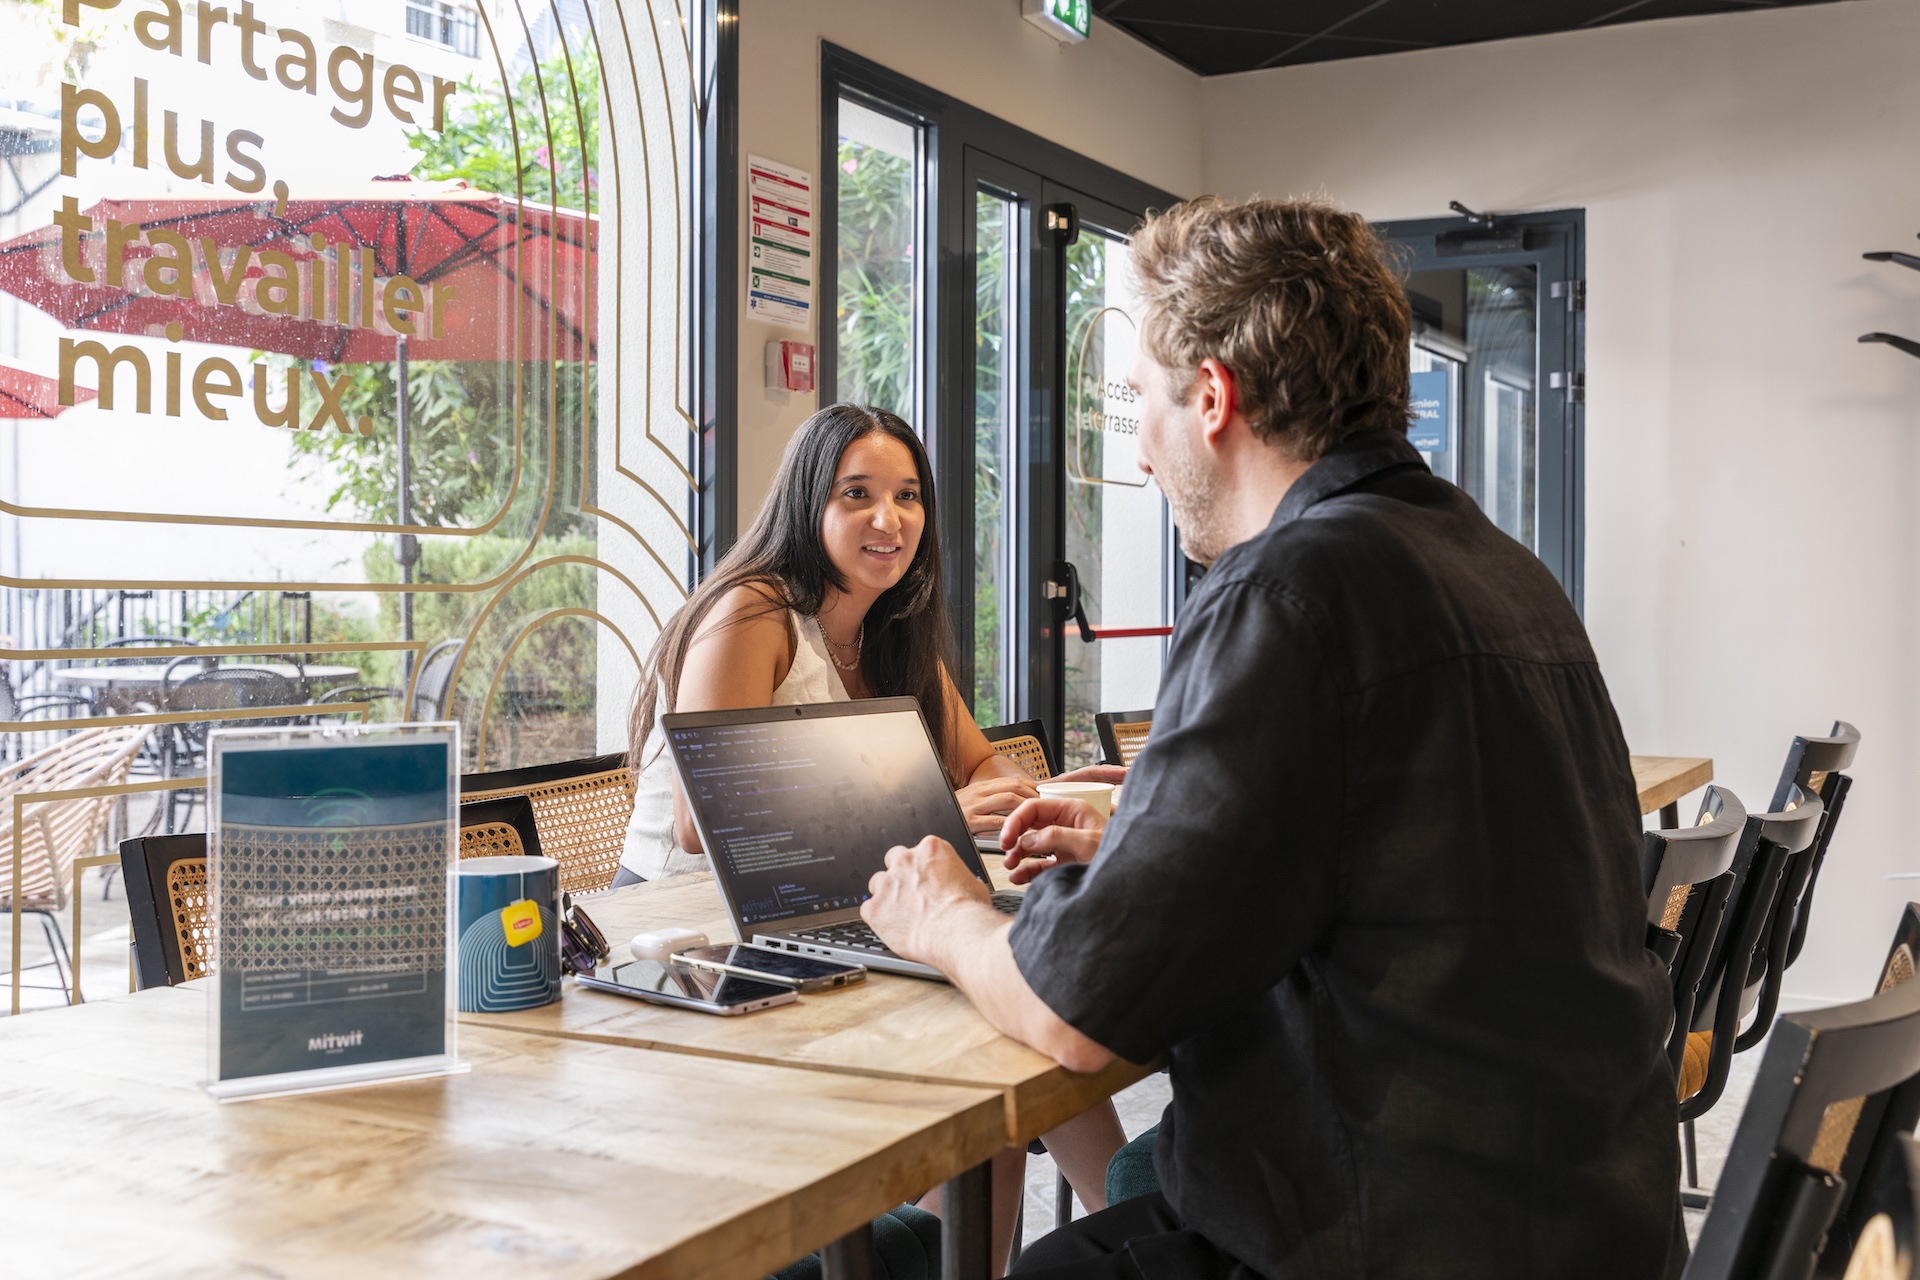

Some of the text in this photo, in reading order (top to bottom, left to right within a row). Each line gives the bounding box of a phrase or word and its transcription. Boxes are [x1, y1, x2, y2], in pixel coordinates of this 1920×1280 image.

[60, 77, 289, 217] plus,
[53, 194, 457, 341] travailler
[57, 322, 373, 437] mieux.
[1088, 406, 1139, 436] terrasse
[1097, 375, 1135, 403] Accès
